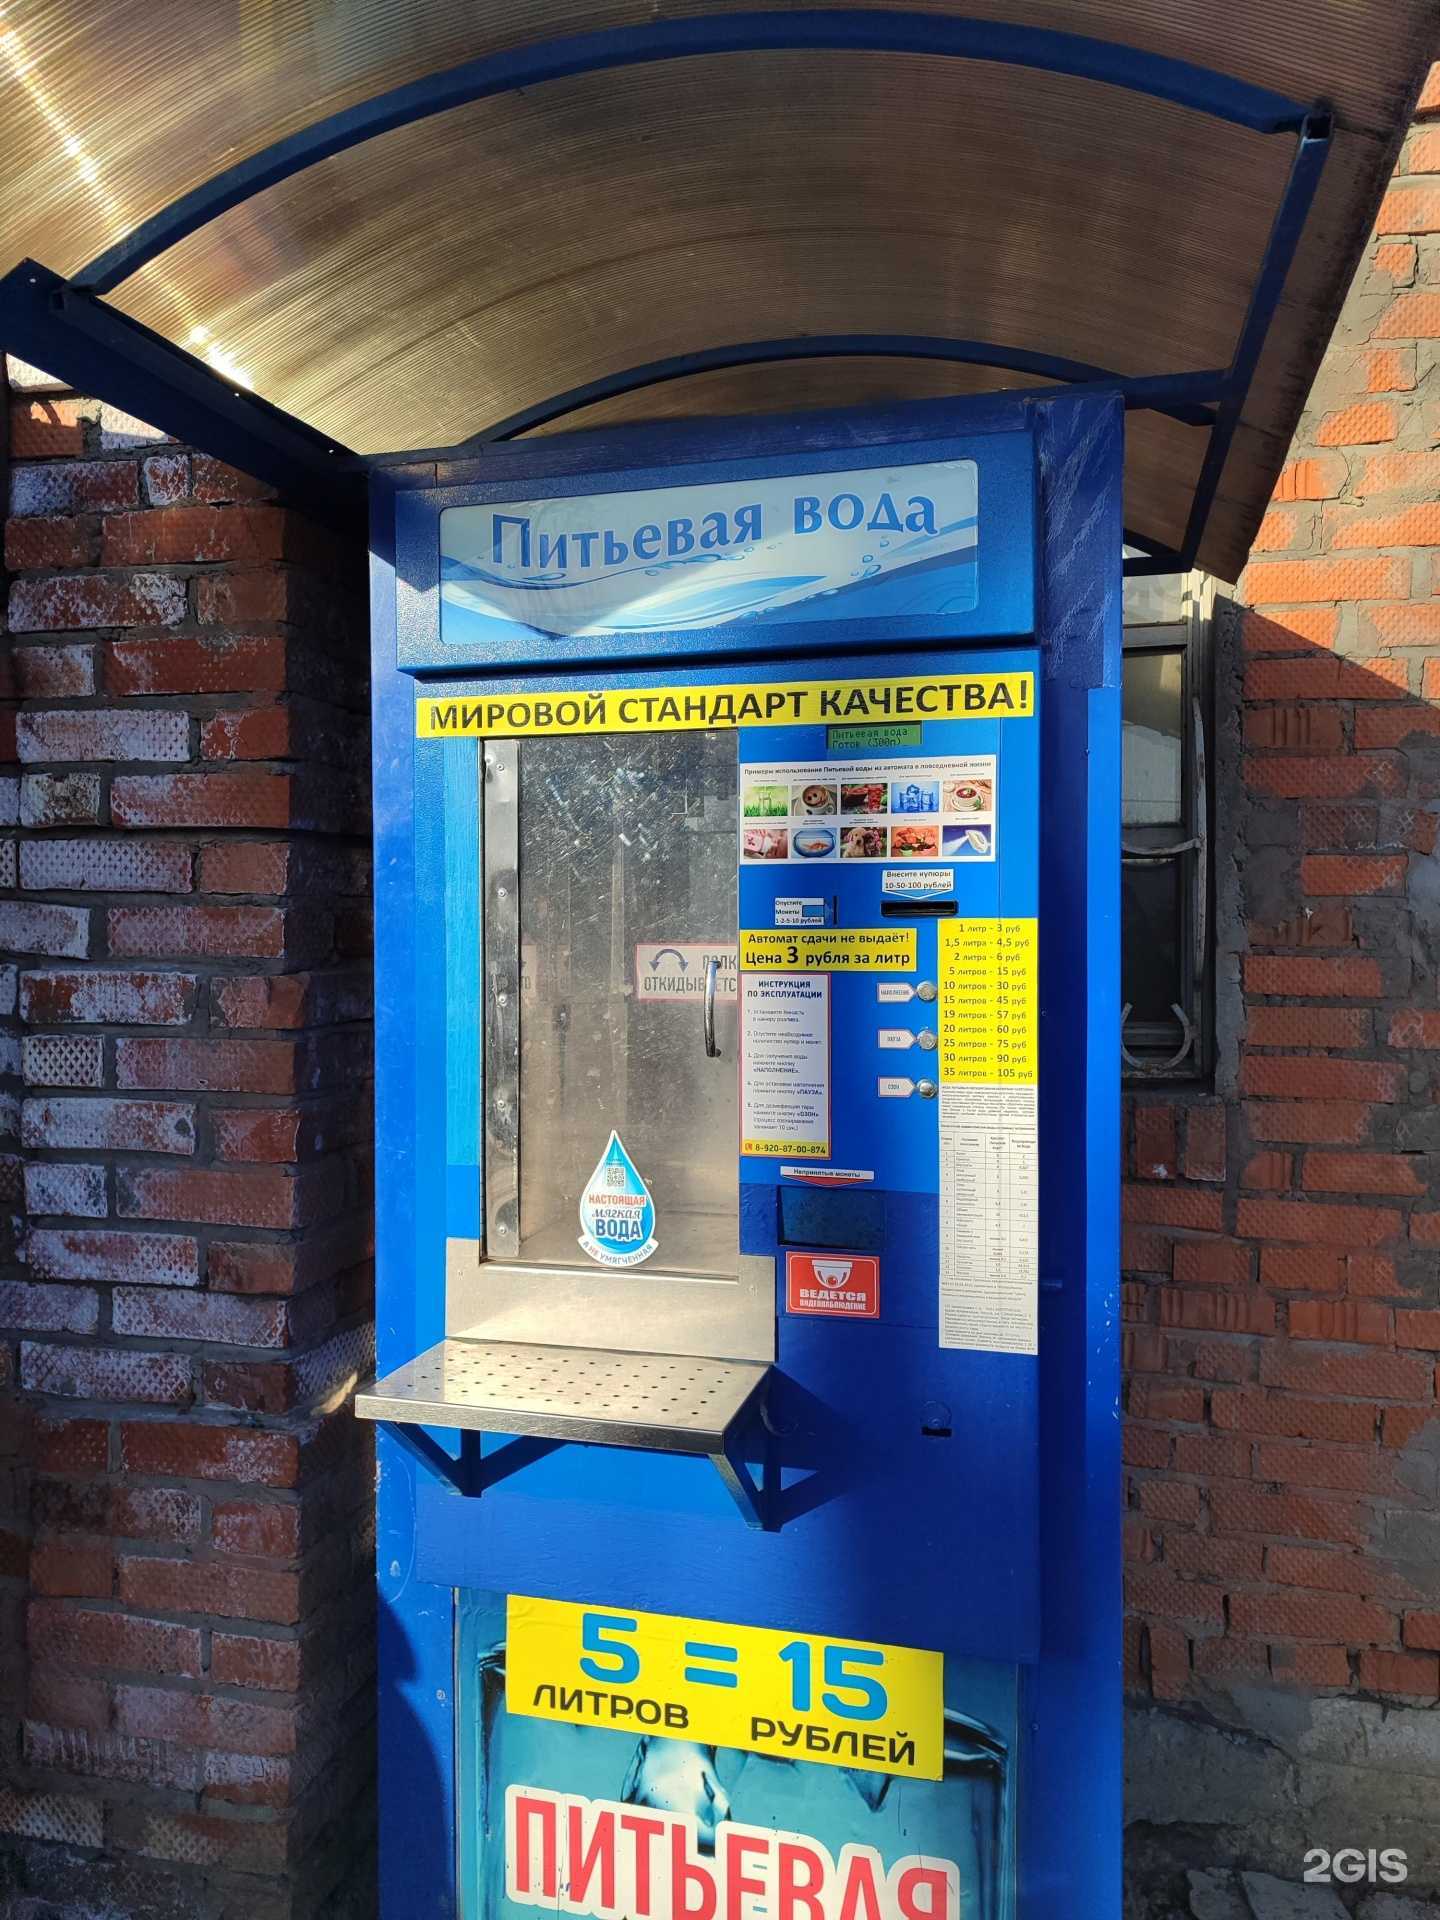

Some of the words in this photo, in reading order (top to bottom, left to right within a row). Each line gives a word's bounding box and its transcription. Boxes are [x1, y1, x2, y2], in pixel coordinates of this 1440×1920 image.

[492, 503, 763, 569] Питьевая
[793, 492, 938, 536] вода
[430, 693, 606, 732] МИРОВОЙ
[619, 690, 807, 726] СТАНДАРТ
[820, 681, 1028, 717] КАЧЕСТВА!
[832, 730, 878, 739] Питьевая
[924, 881, 951, 889] рублей
[959, 924, 964, 932] 1
[968, 926, 986, 934] литр
[997, 924, 1002, 932] 3
[1005, 925, 1020, 933] руб
[748, 933, 798, 944] Автомат
[801, 934, 836, 945] сдачи
[841, 934, 856, 943] не
[859, 932, 909, 944] выдаёт!
[945, 938, 959, 947] 1,5
[997, 938, 1012, 947] 4,5
[1015, 938, 1030, 947] руб
[746, 951, 782, 966] Цена
[786, 946, 798, 964] 3
[806, 950, 850, 966] рубля
[854, 953, 869, 964] за
[875, 953, 910, 965] литр
[1005, 953, 1020, 962] руб
[949, 967, 955, 975] 5
[958, 968, 986, 976] литров
[997, 967, 1008, 975] 15
[1011, 967, 1026, 976] руб
[758, 980, 811, 989] ИНСТРУКЦИЯ
[944, 981, 955, 989] 10
[997, 981, 1008, 989] 30
[1011, 982, 1026, 990] руб
[748, 990, 758, 998] ПО
[761, 990, 822, 999] ЭКСПЛУАТАЦИИ
[944, 996, 955, 1004] 15
[958, 997, 986, 1005] литров
[997, 996, 1008, 1004] 45
[1011, 996, 1026, 1005] руб
[944, 1010, 955, 1018] 19
[997, 1010, 1008, 1018] 57
[1011, 1011, 1026, 1020] руб
[944, 1024, 955, 1033] 20
[997, 1025, 1009, 1033] 60
[1011, 1025, 1027, 1034] руб
[944, 1039, 955, 1047] 25
[958, 1040, 986, 1048] литров
[997, 1039, 1009, 1048] 75
[1011, 1039, 1027, 1049] руб
[944, 1053, 955, 1061] 30
[958, 1055, 986, 1063] литров
[997, 1054, 1009, 1063] 90
[1011, 1055, 1027, 1064] руб
[944, 1068, 955, 1076] 35
[958, 1069, 986, 1077] литров
[998, 1069, 1015, 1077] 105
[1018, 1070, 1033, 1078] руб
[756, 1144, 826, 1154] 8-920-87-00-874
[588, 1194, 646, 1206] НАСТОЯЩАЯ
[592, 1208, 640, 1219] мягкая
[596, 1219, 641, 1240] ВОДА
[799, 1289, 866, 1302] ВЕДЕТСЯ
[799, 1299, 866, 1311] ВИДЕОНАБЛЮДЕНИЕ
[579, 1612, 641, 1684] 5
[778, 1641, 888, 1721] 15
[532, 1684, 689, 1729] ЛИТРОВ
[751, 1717, 916, 1766] РУБЛЕЙ
[515, 1796, 947, 1920] ПИТЬЕВАЯ
